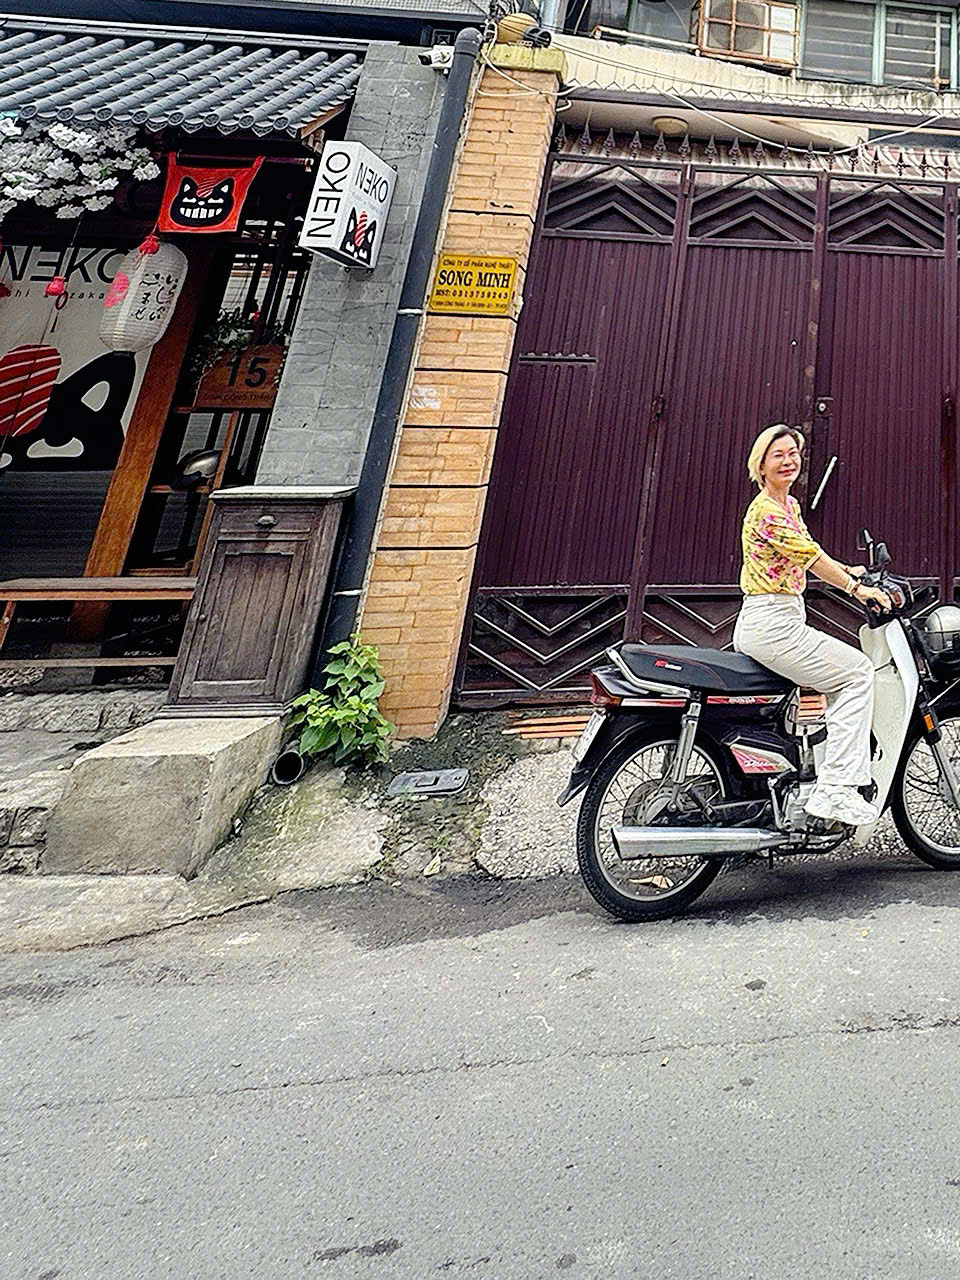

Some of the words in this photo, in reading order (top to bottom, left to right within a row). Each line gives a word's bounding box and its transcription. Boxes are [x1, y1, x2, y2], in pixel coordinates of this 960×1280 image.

[306, 151, 351, 237] NEKO
[355, 162, 389, 203] NEKO
[438, 269, 473, 286] SONG
[476, 272, 511, 288] MINH
[224, 353, 270, 387] 15
